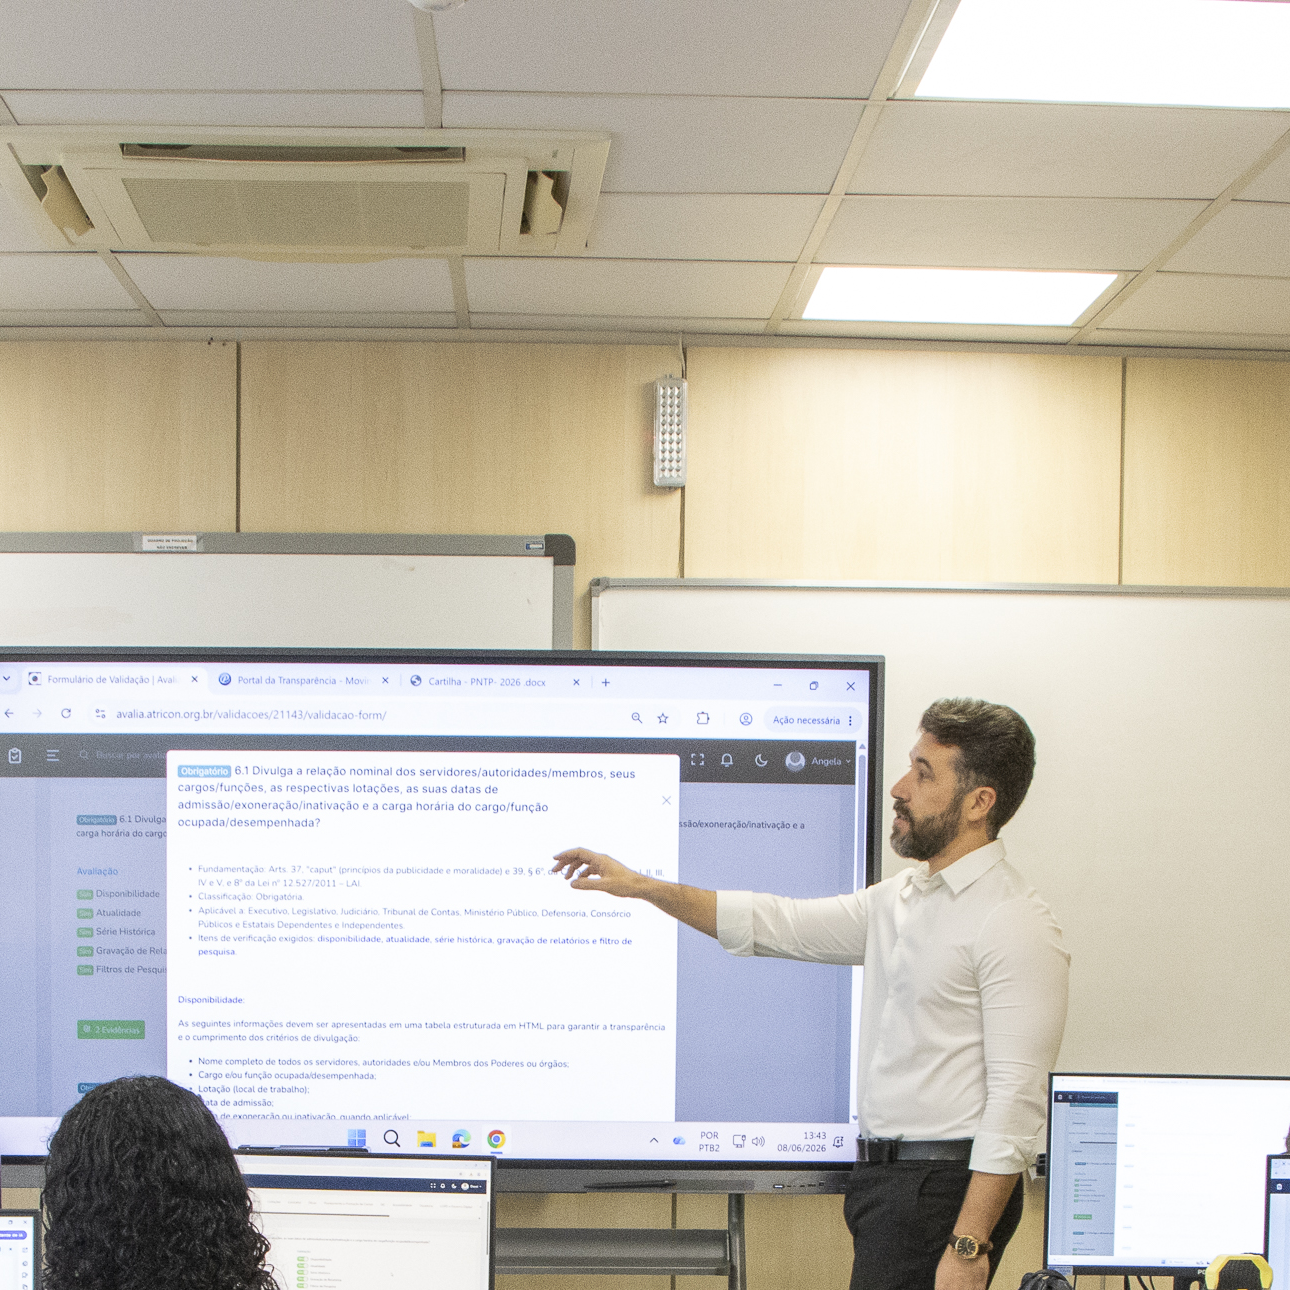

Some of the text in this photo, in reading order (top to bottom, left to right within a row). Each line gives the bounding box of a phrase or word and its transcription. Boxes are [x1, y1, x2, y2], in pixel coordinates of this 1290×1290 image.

[48, 675, 149, 685] Formulário de Validação
[238, 676, 336, 686] Portal da Transparência
[428, 677, 461, 685] Cartilha
[500, 678, 520, 686] 2026
[116, 709, 386, 721] avalia.atricon.org.br/validacoes/21143/validacao-form/
[773, 716, 794, 725] Ação
[811, 757, 842, 768] Angela
[181, 767, 228, 778] Obrigatório
[234, 765, 248, 774] 6.1
[252, 765, 292, 777] Divulga
[306, 766, 346, 777] relação
[350, 767, 392, 776] nominal
[395, 767, 415, 776] dos
[286, 784, 349, 794] respectivas
[353, 783, 402, 794] lotações,
[450, 784, 481, 793] datas
[484, 785, 498, 793] de
[178, 800, 359, 811] admissão/exoneração/inativação
[382, 803, 412, 812] carga
[416, 802, 454, 810] horária
[457, 802, 471, 811] do
[474, 802, 548, 813] cargo/função
[178, 818, 320, 828] ocupada/desempenhada?
[77, 867, 118, 876] Avaliação
[96, 889, 159, 898] Disponibilidade
[198, 892, 304, 902] Classificação: Obrigatória.
[198, 906, 236, 915] Aplicável
[292, 907, 337, 916] Legislativo,
[430, 908, 460, 916] Contas,
[541, 909, 588, 917] Defensoria,
[590, 909, 631, 917] Consórcio
[232, 934, 276, 943] verificação
[278, 936, 315, 944] exigidos:
[496, 936, 534, 945] gravação
[178, 995, 245, 1004] Disponibilidade:
[191, 1020, 230, 1028] seguintes
[233, 1020, 283, 1029] informações
[610, 1023, 665, 1031] transparência
[224, 1058, 263, 1066] completo
[539, 1060, 568, 1069] órgãos;
[198, 1070, 222, 1080] Cargo
[244, 1071, 272, 1080] função
[198, 1085, 230, 1095] Lotação
[270, 1086, 309, 1094] trabalho);
[700, 1131, 718, 1139] POR
[804, 1131, 826, 1139] 13:43
[699, 1144, 719, 1152] PTB2
[777, 1144, 826, 1152] 08/06/2026
